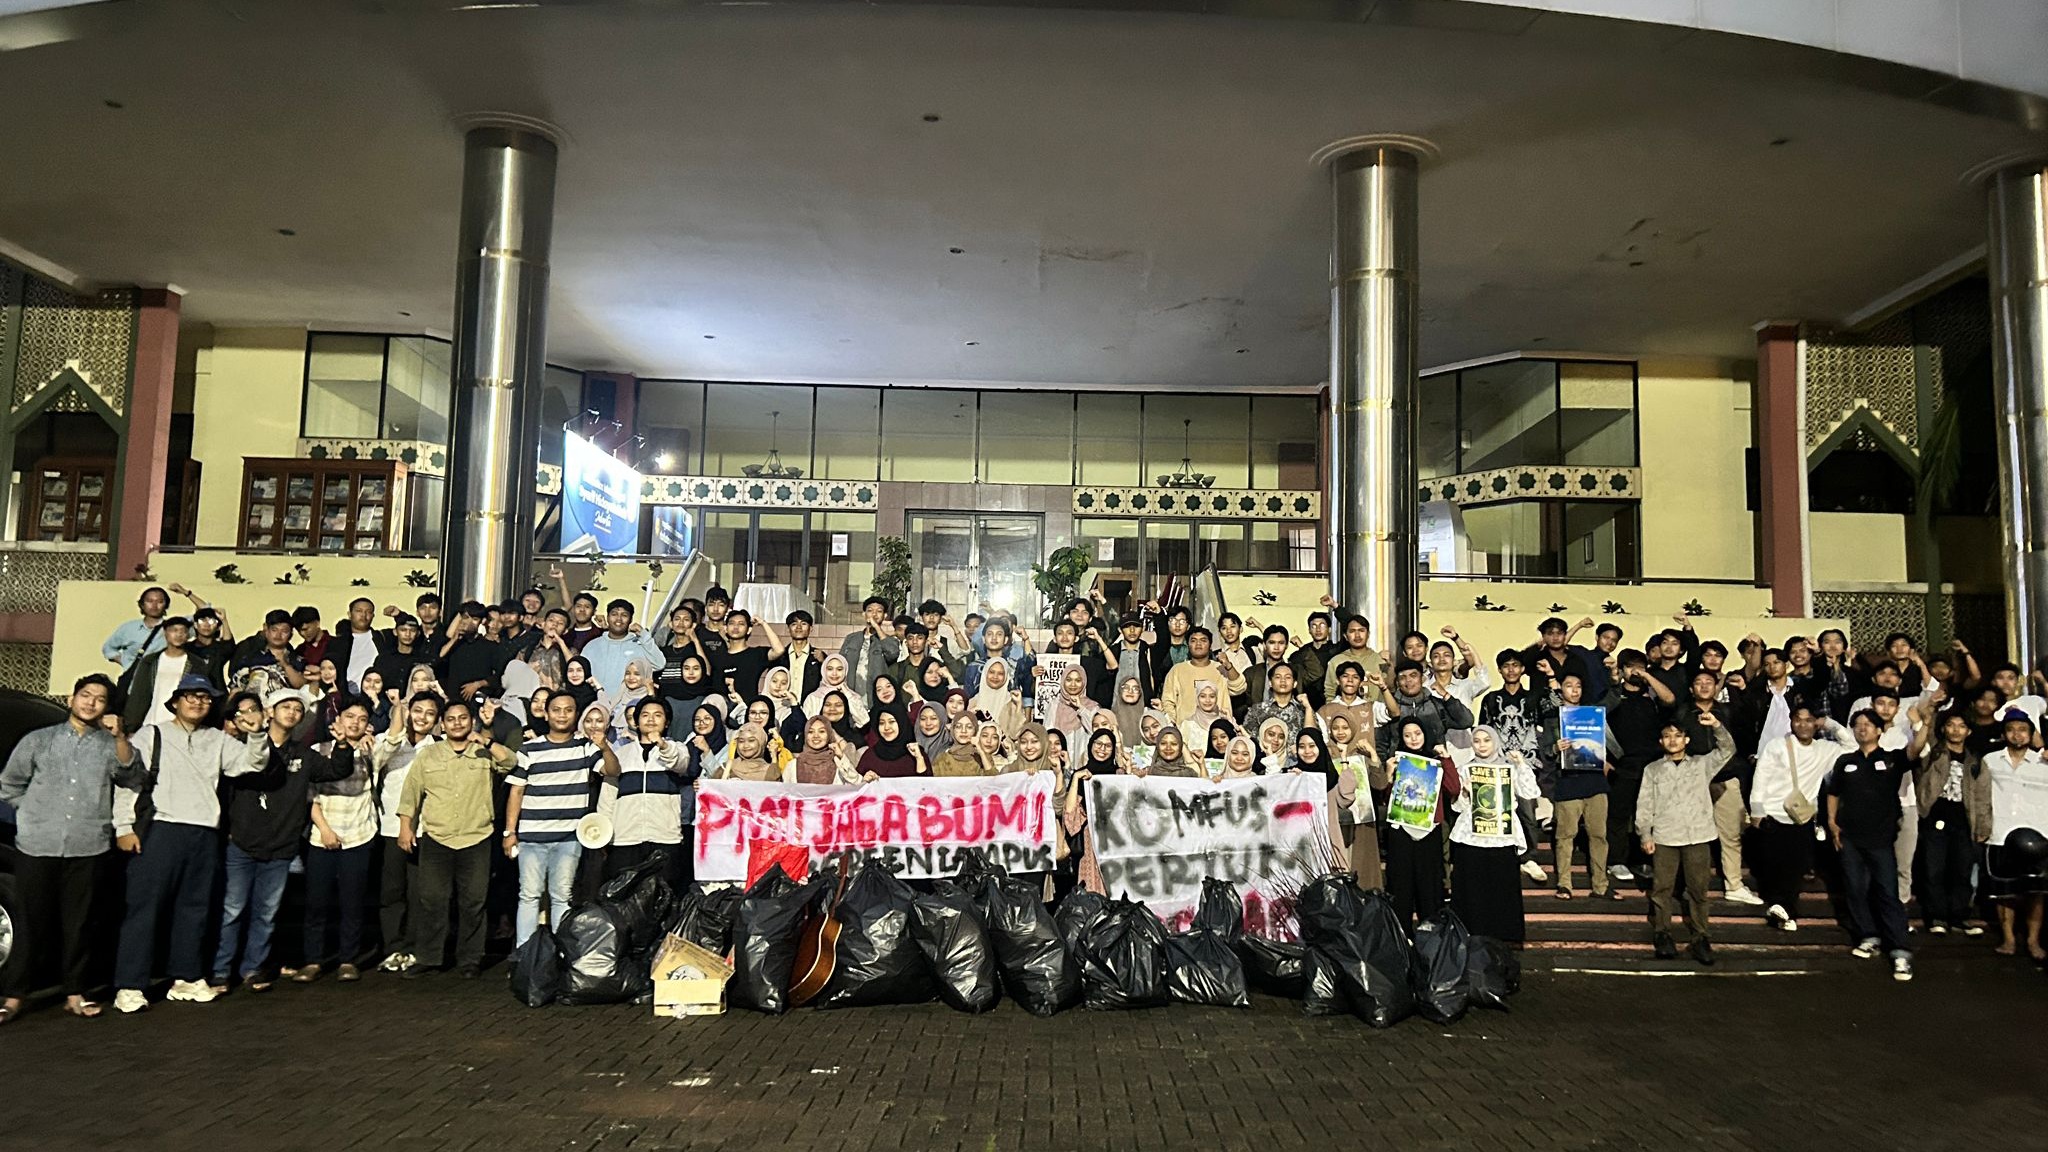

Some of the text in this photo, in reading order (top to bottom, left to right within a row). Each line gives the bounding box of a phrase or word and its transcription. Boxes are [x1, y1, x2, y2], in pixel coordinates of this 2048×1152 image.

[1049, 661, 1067, 669] FREE
[1040, 669, 1064, 681] ALES
[1471, 767, 1490, 777] SAVE
[812, 795, 908, 853] JAGA
[917, 791, 1046, 844] BUMI
[1476, 826, 1504, 834] PLAN
